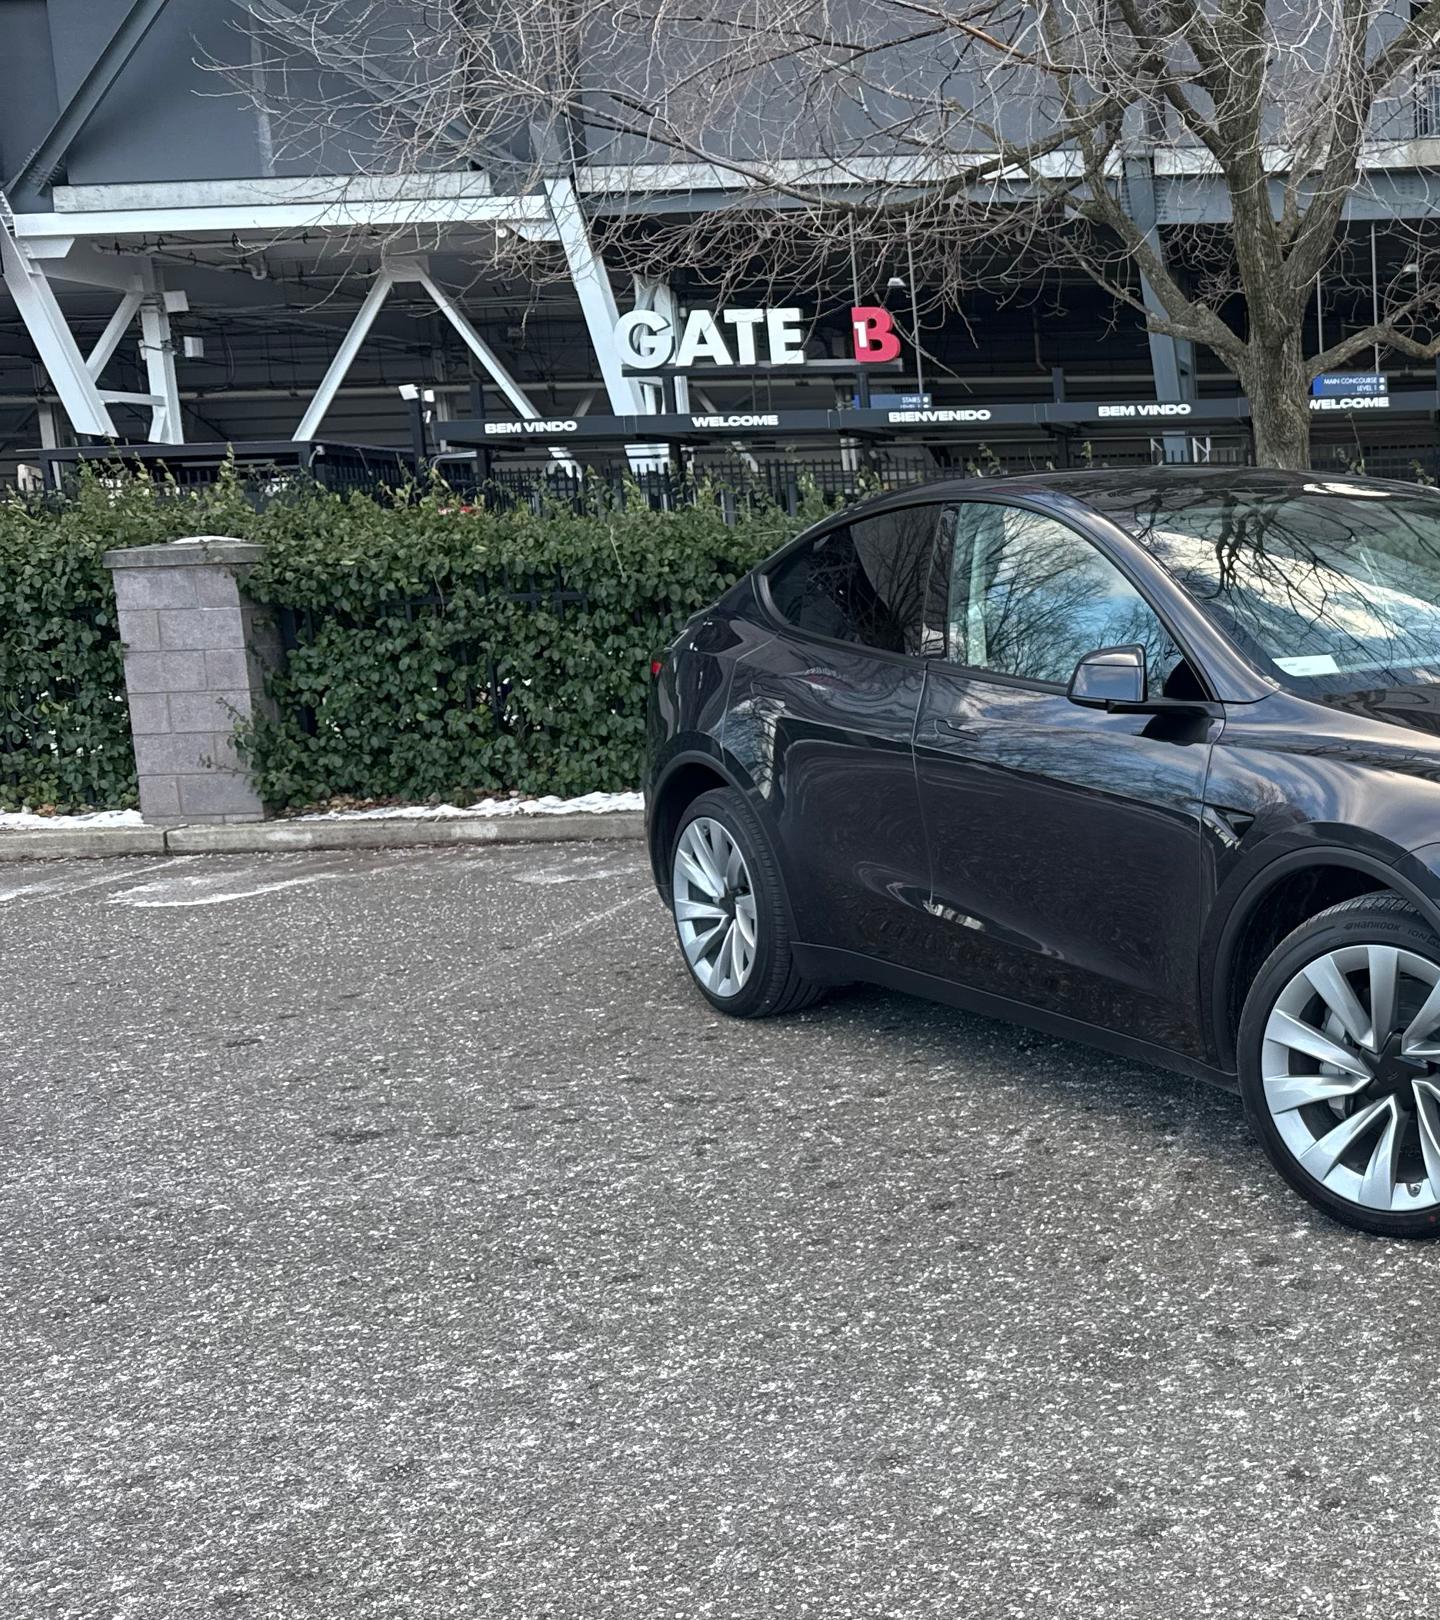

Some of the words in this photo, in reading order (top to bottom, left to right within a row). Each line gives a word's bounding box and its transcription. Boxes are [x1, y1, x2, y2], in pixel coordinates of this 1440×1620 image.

[613, 307, 805, 370] GATE
[888, 410, 991, 422] BIENVENIDO
[1098, 405, 1136, 417] BEM
[1136, 403, 1192, 416] VINDO
[484, 422, 522, 435] BEM
[523, 420, 578, 433] VINDO
[691, 414, 779, 428] WELCOME
